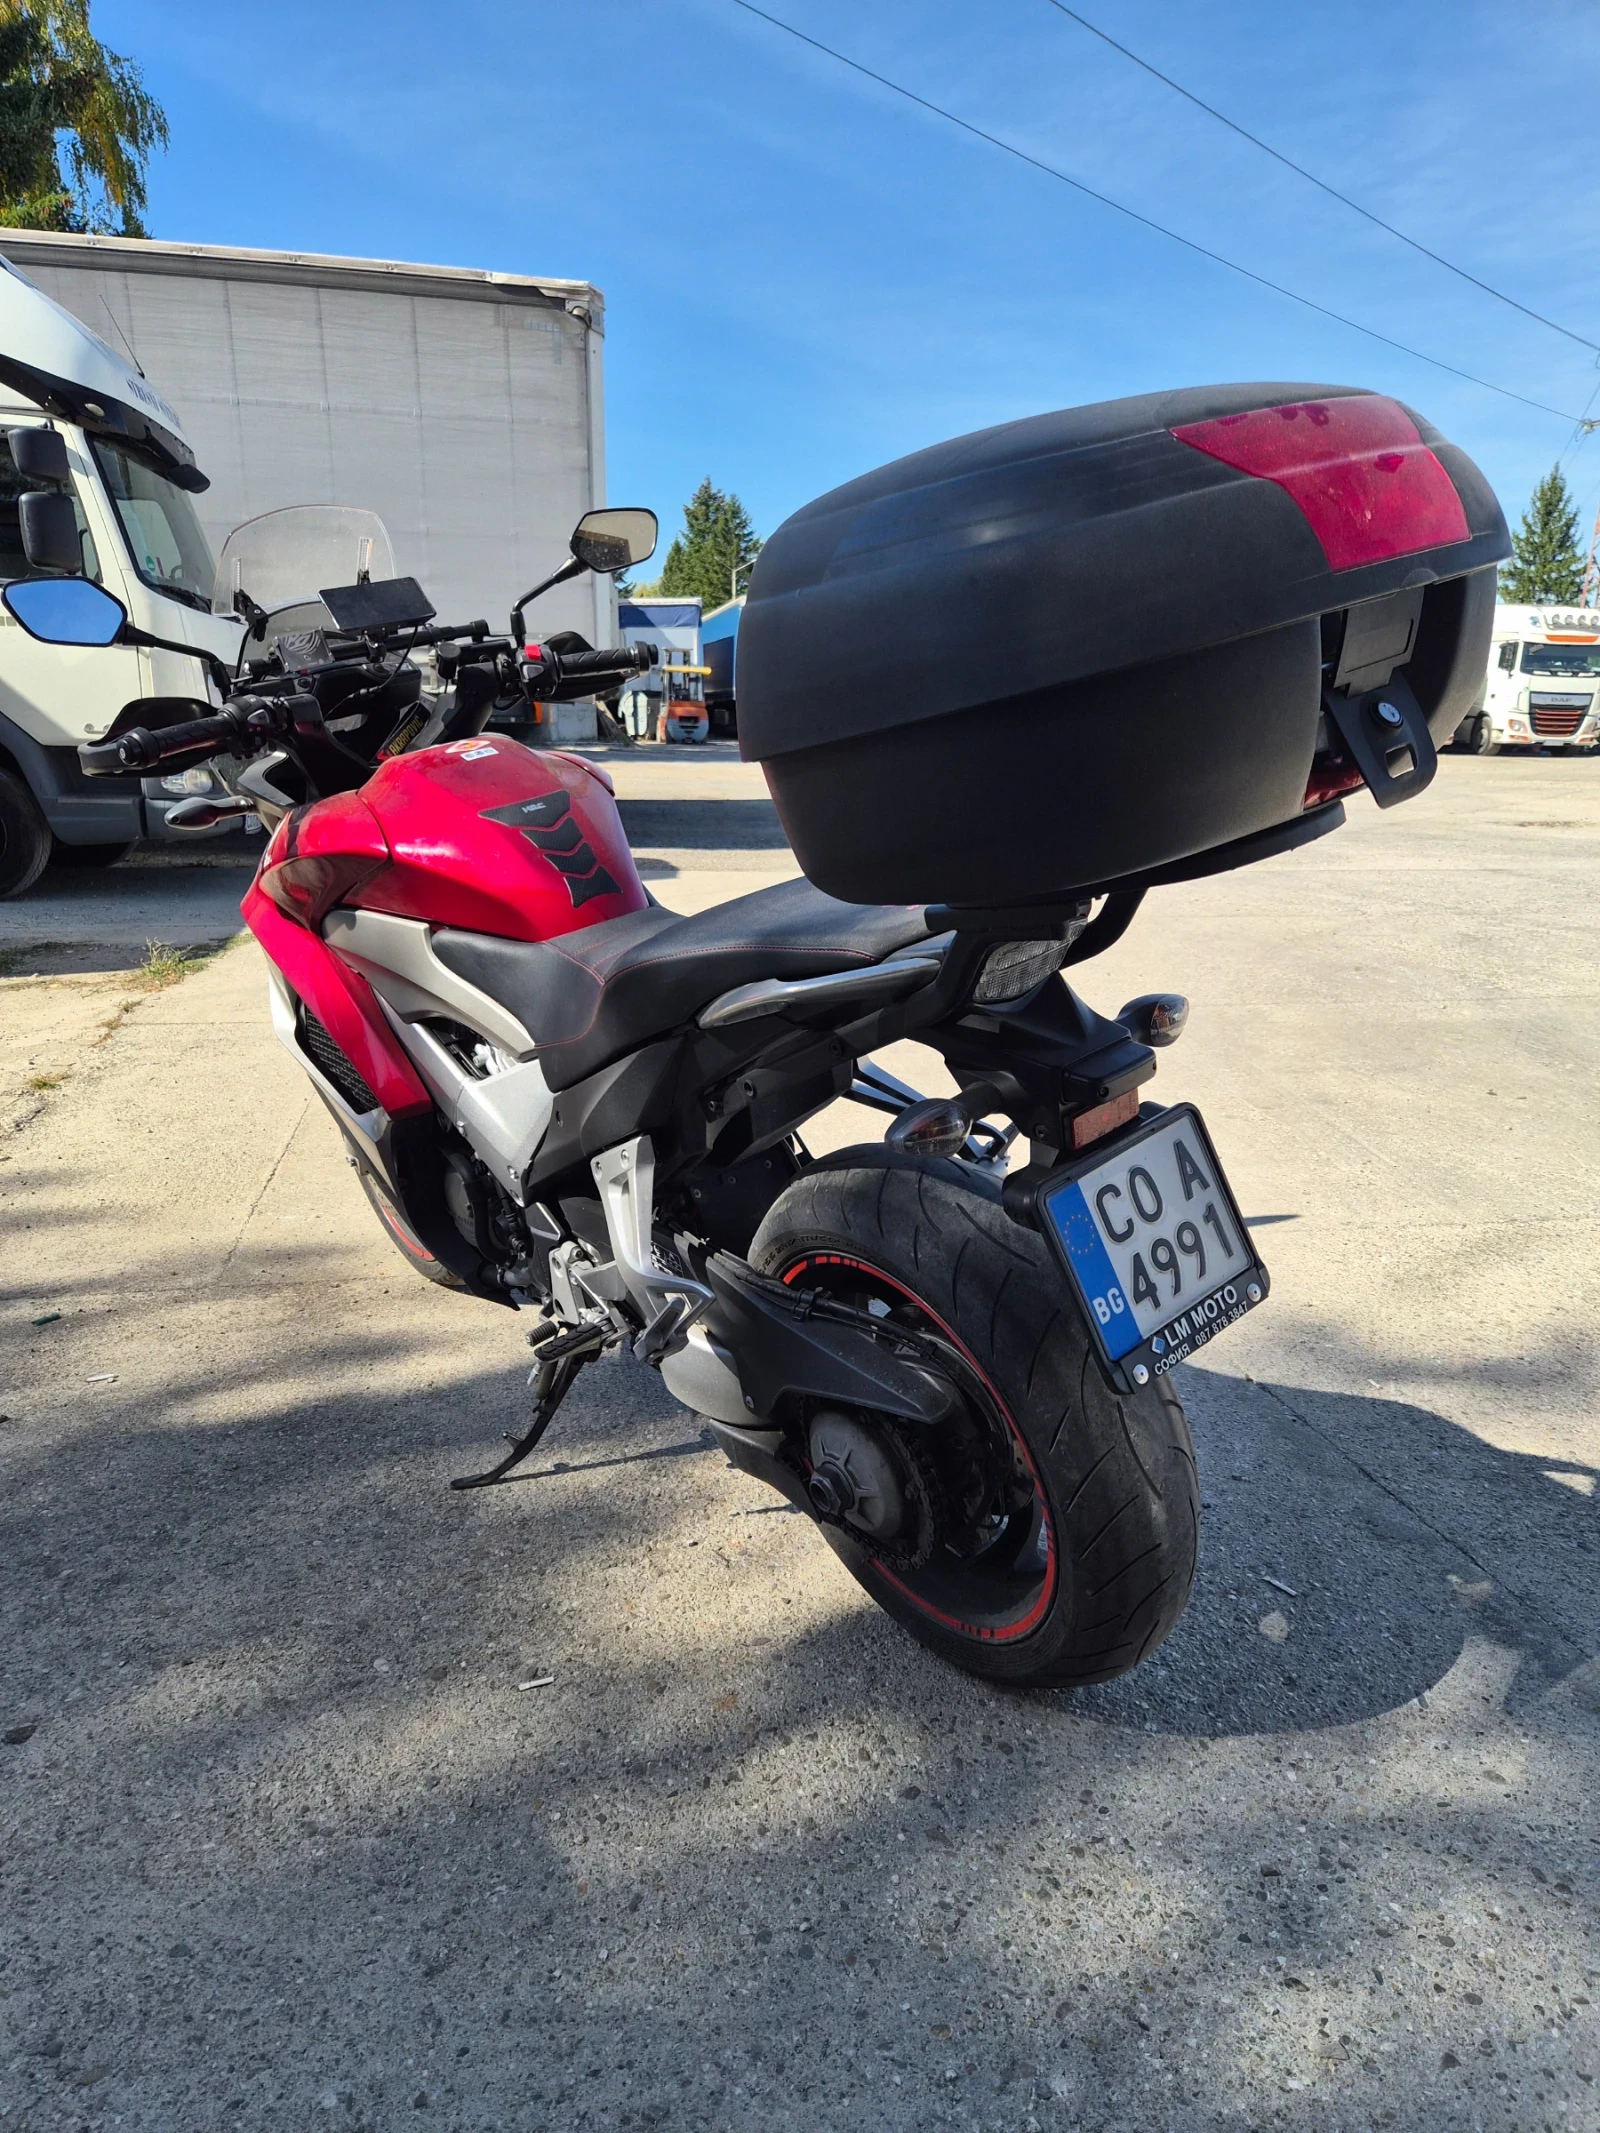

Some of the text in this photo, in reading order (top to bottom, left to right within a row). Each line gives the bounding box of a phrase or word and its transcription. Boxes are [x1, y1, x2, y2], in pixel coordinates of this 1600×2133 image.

[1096, 1140, 1210, 1243] CO A
[1132, 1203, 1235, 1310] 4991
[1093, 1287, 1125, 1325] BG
[1164, 1285, 1237, 1347] LM MOTO
[1194, 1300, 1248, 1346] 087 878 3847
[1154, 1343, 1191, 1375] СОФИЯ
